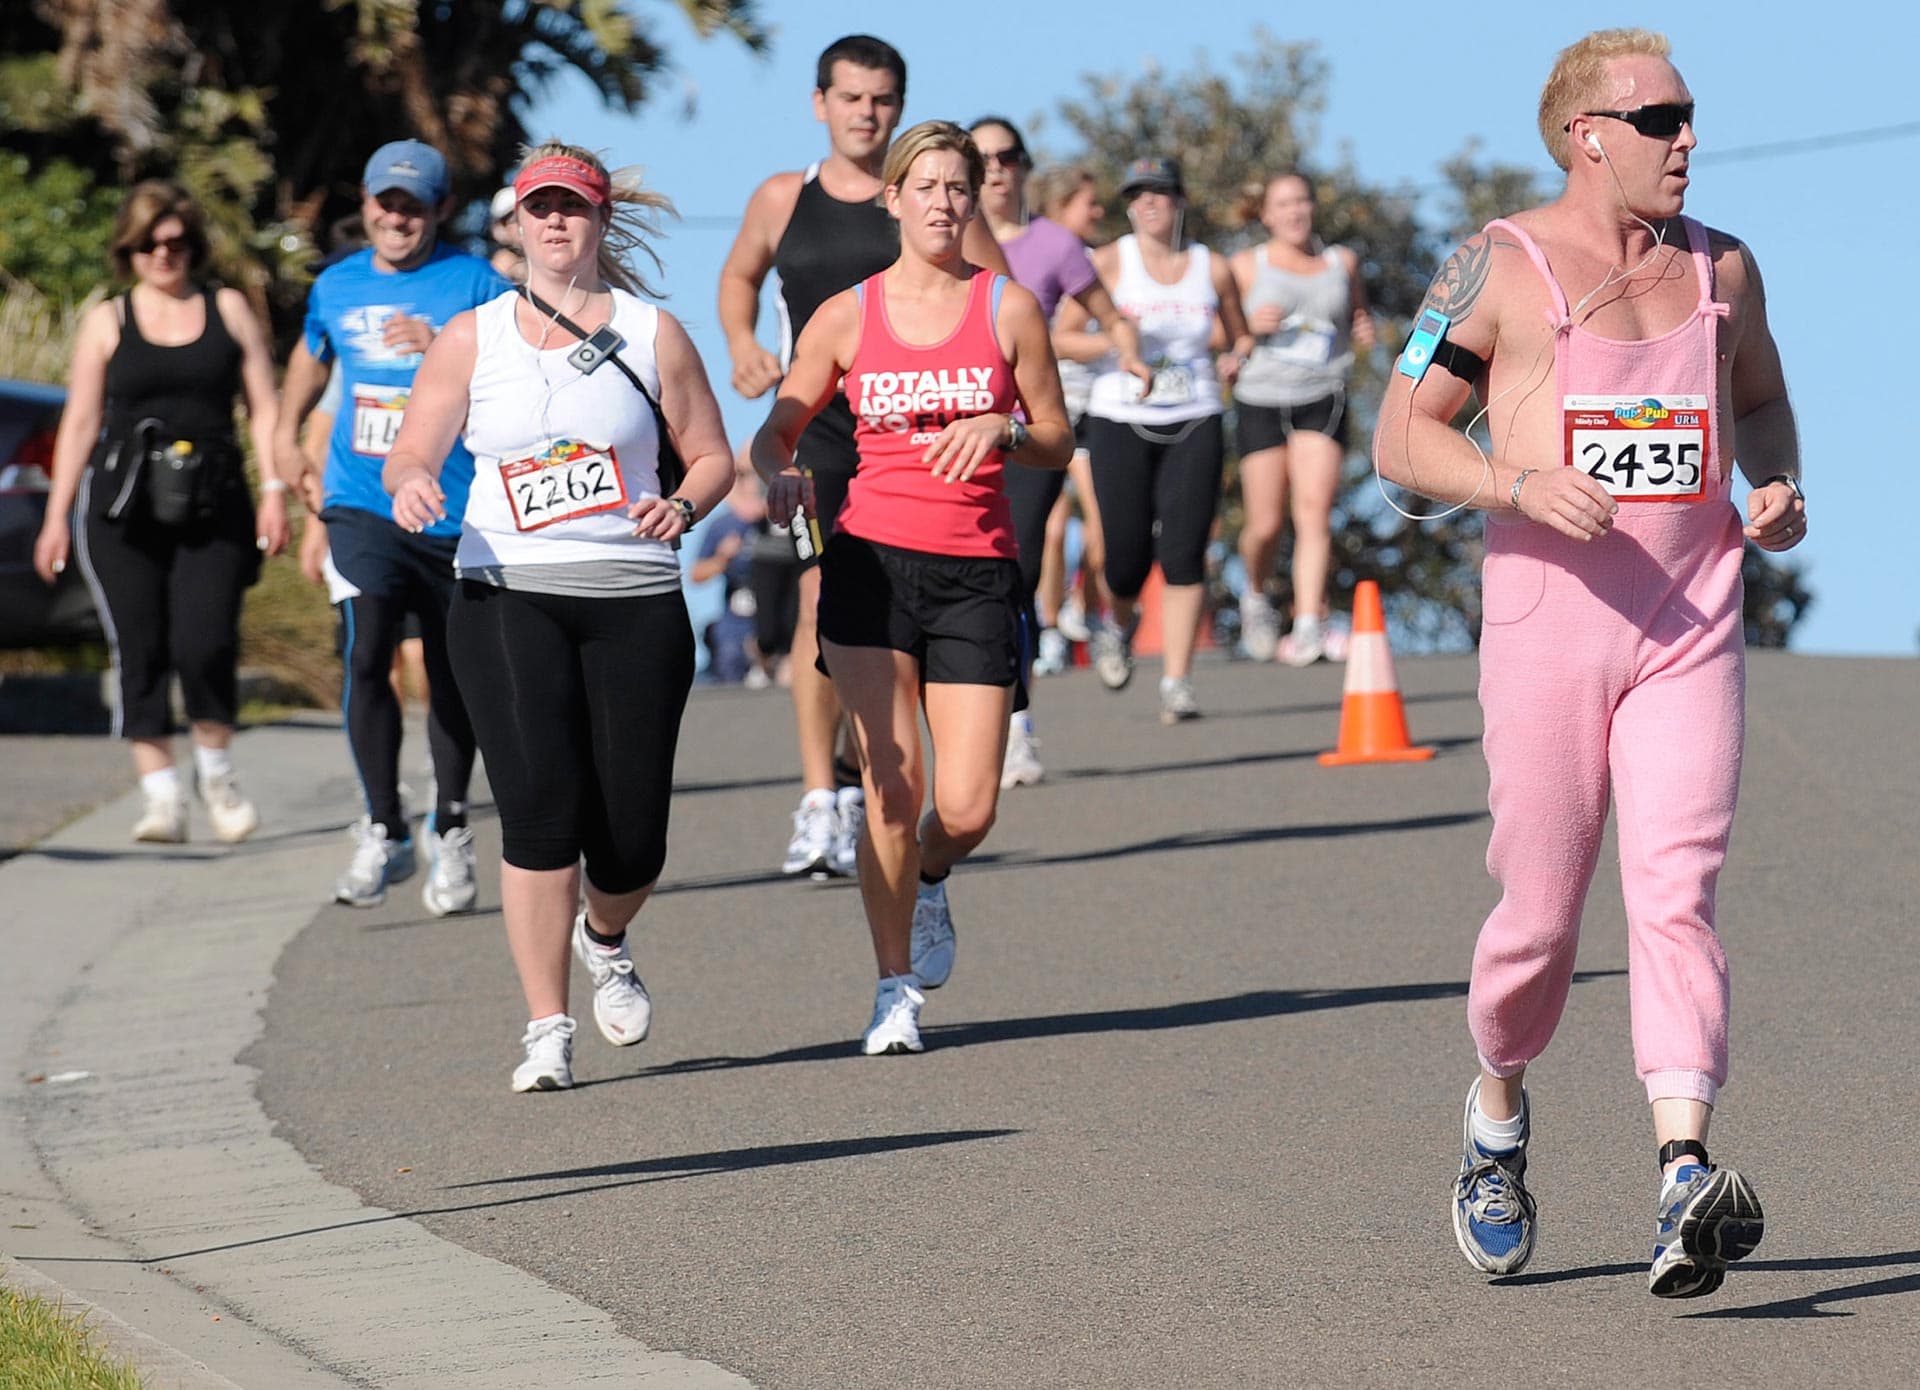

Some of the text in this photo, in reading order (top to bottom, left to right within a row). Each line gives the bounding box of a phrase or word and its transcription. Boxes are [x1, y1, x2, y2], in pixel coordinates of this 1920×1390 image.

[859, 367, 993, 398] TOTALLY
[859, 391, 994, 416] ADDICTED
[1614, 406, 1669, 421] Pub2Pub
[862, 413, 910, 434] TO
[1674, 415, 1699, 425] URM
[1582, 442, 1700, 488] 2435
[517, 462, 615, 516] 2262
